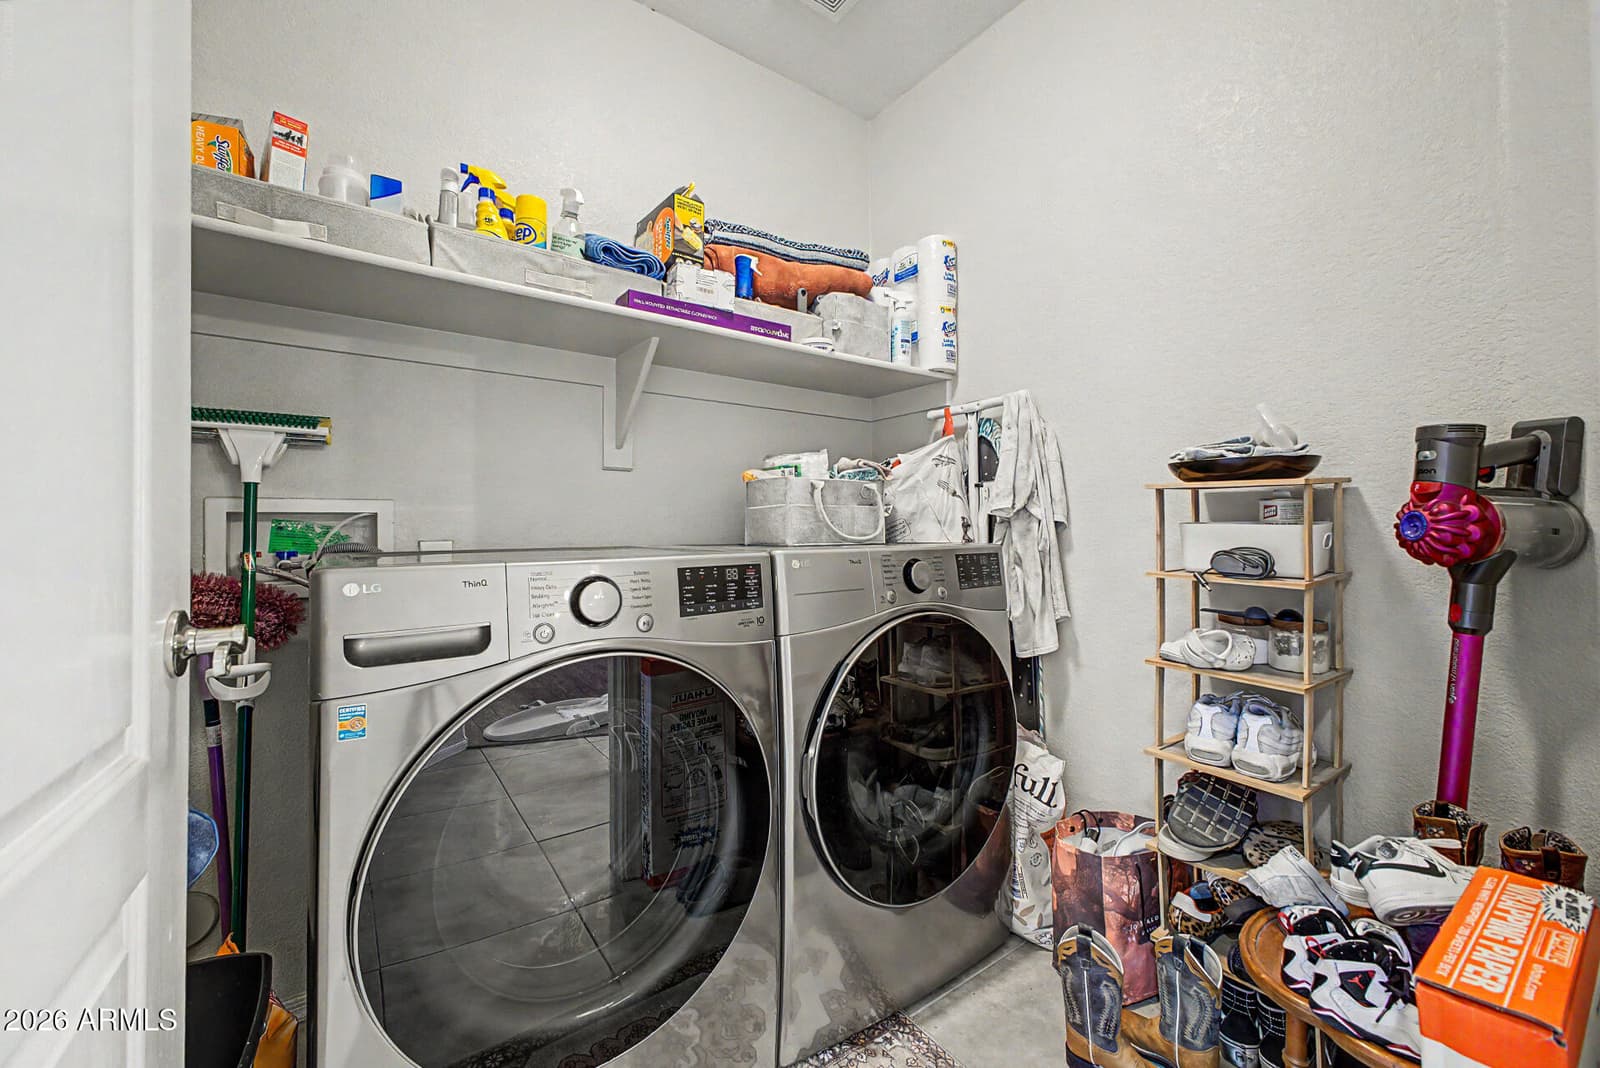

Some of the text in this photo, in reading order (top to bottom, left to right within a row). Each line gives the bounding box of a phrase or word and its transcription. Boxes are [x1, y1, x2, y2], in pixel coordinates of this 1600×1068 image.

[195, 126, 205, 152] HEAVY
[362, 584, 382, 594] LG
[462, 579, 488, 588] ThinQ
[1014, 763, 1057, 808] full
[1459, 882, 1542, 994] WRAPPING PAPER
